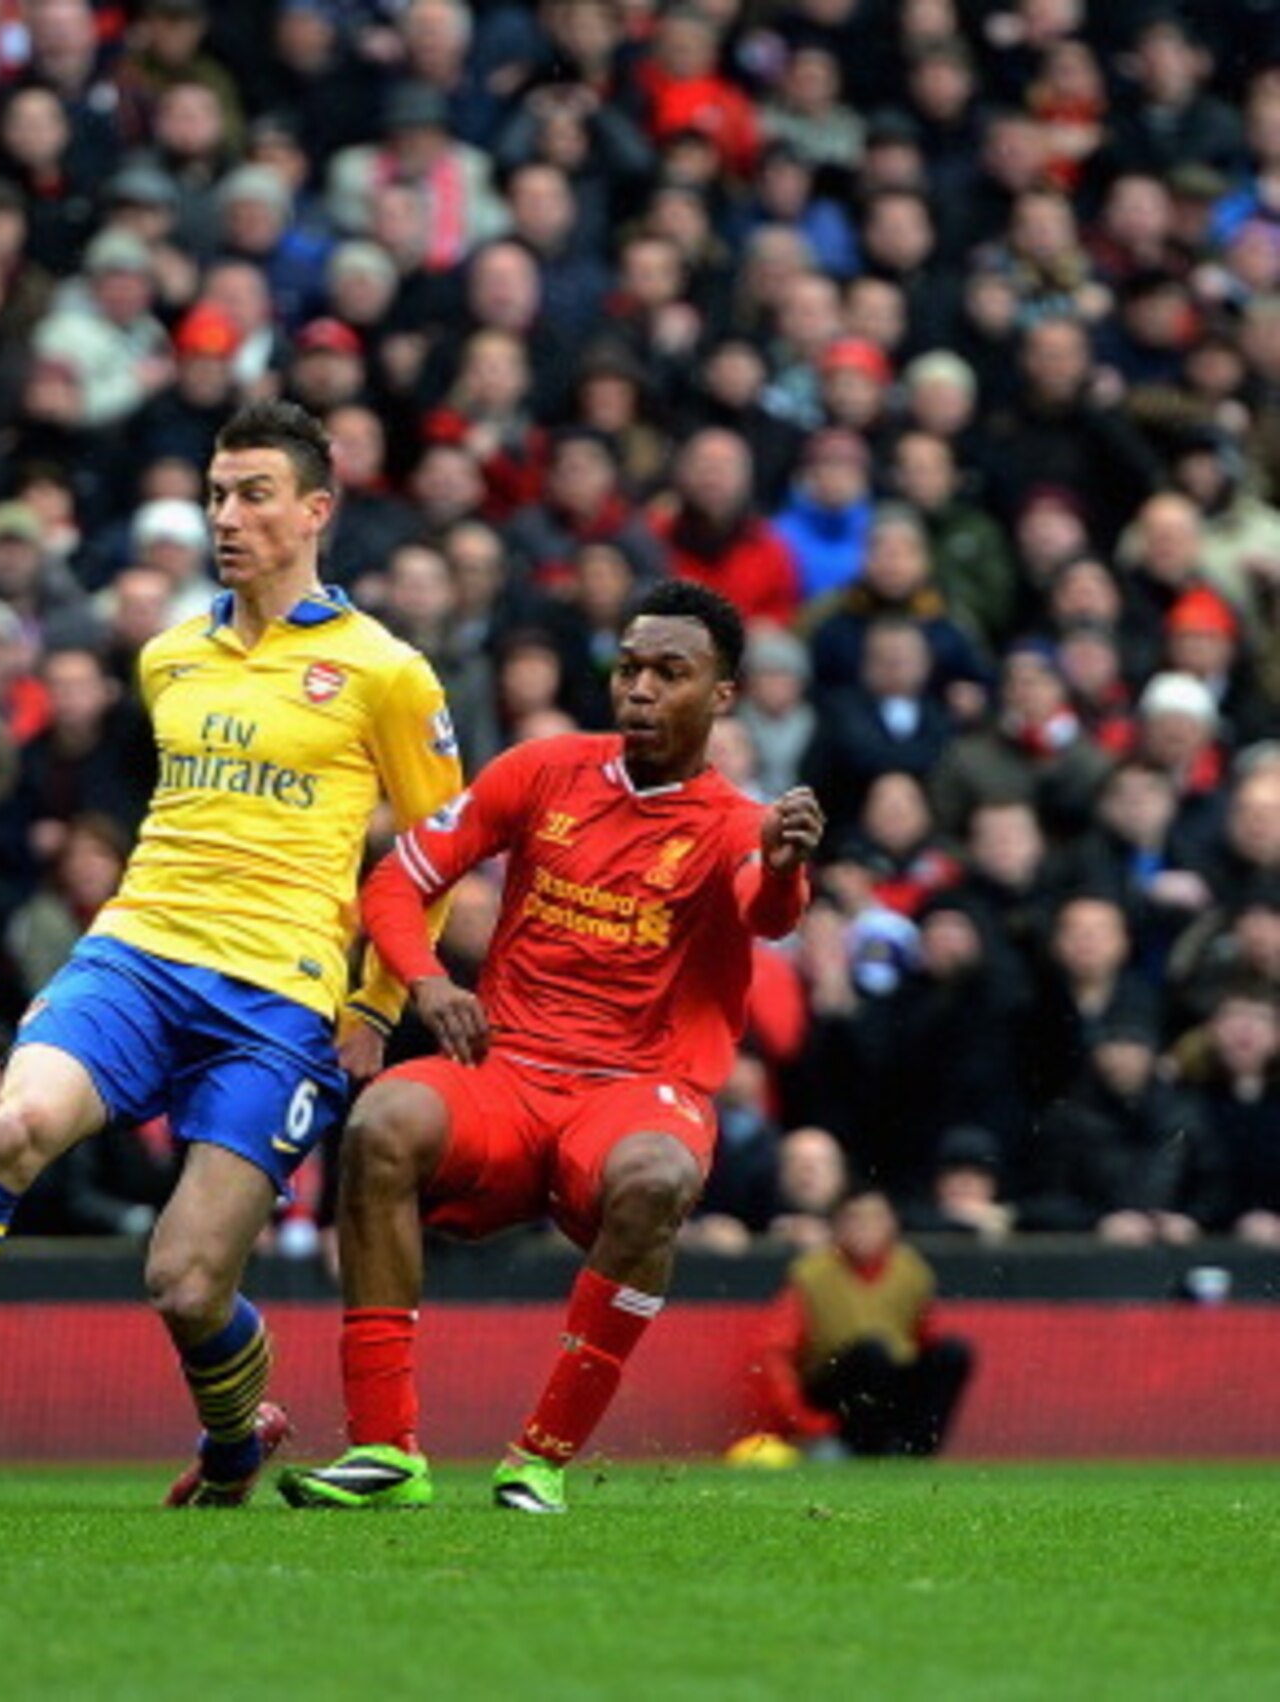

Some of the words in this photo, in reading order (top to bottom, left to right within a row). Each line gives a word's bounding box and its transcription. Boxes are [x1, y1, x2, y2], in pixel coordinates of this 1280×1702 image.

[202, 713, 256, 749] Fly
[161, 748, 317, 809] mirates
[286, 1078, 319, 1140] 6
